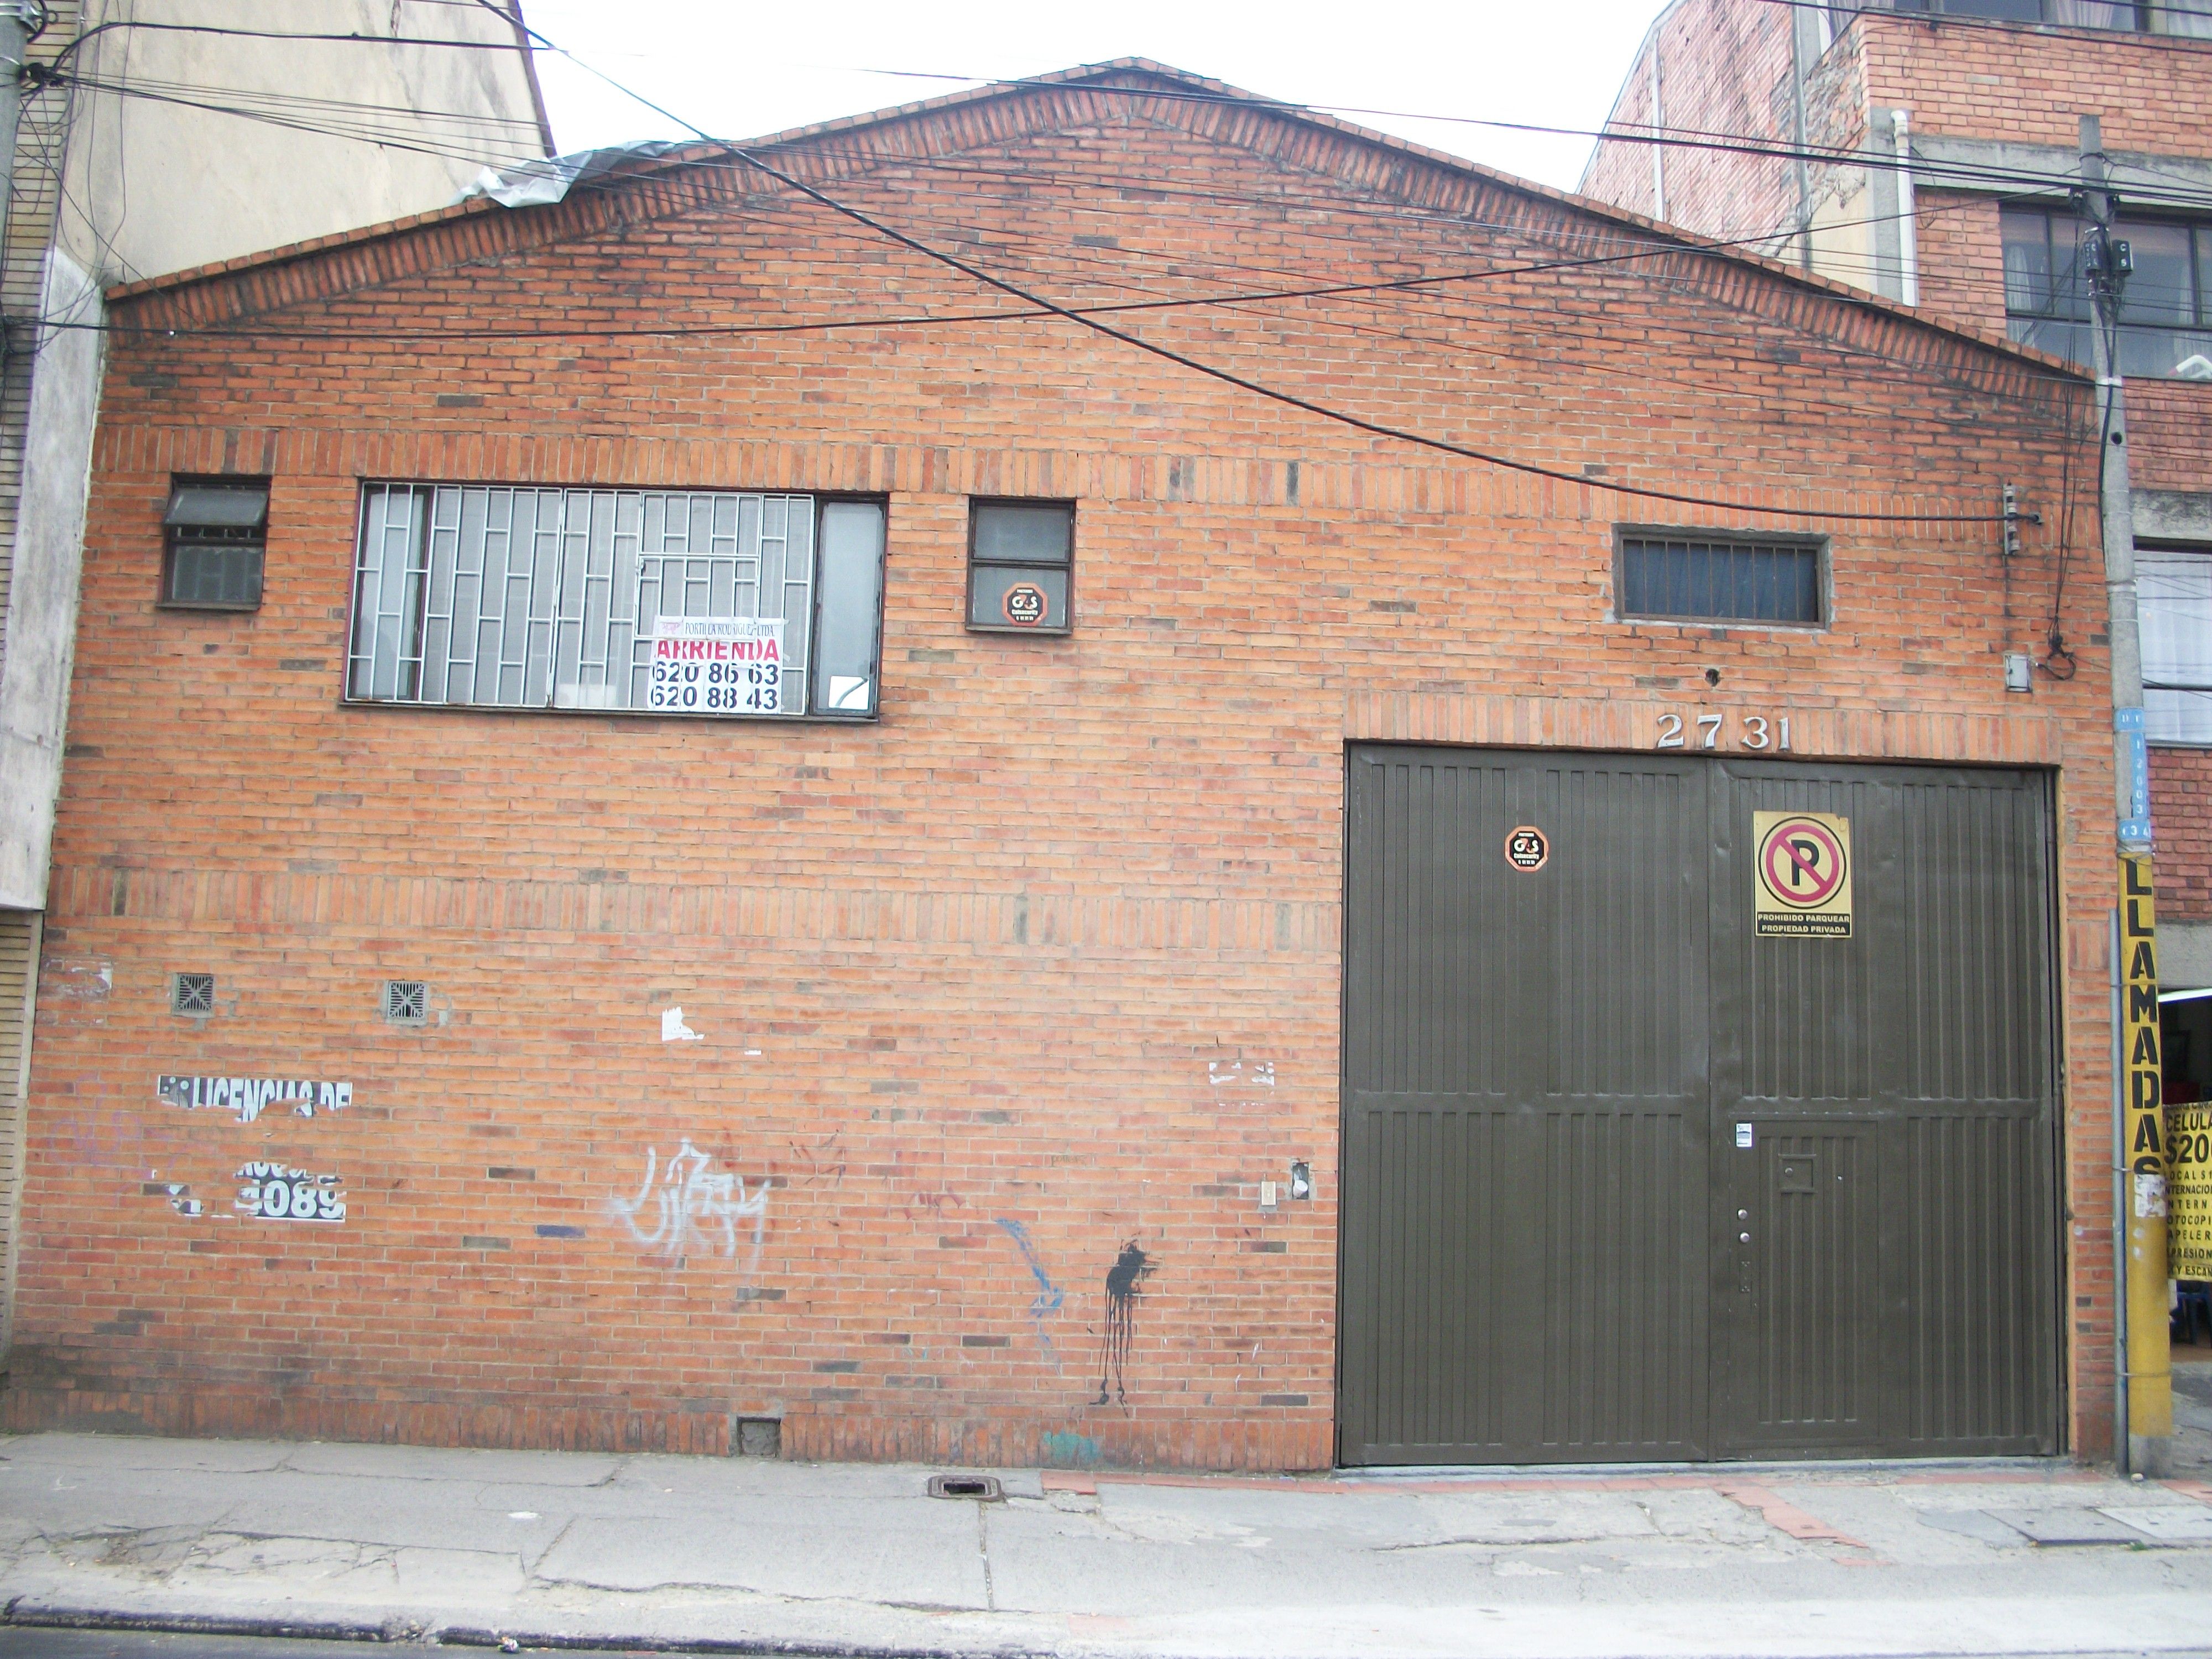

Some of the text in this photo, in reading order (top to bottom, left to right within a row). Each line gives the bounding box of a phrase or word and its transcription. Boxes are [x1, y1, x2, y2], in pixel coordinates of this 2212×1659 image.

[658, 638, 779, 661] ARRIENDA
[653, 661, 779, 685] 620 86 63
[651, 685, 778, 709] 620 88 43
[1657, 713, 1790, 749] 2731
[1791, 839, 1819, 886] P
[2164, 1134, 2212, 1165] $20
[2177, 1265, 2182, 1275] Y
